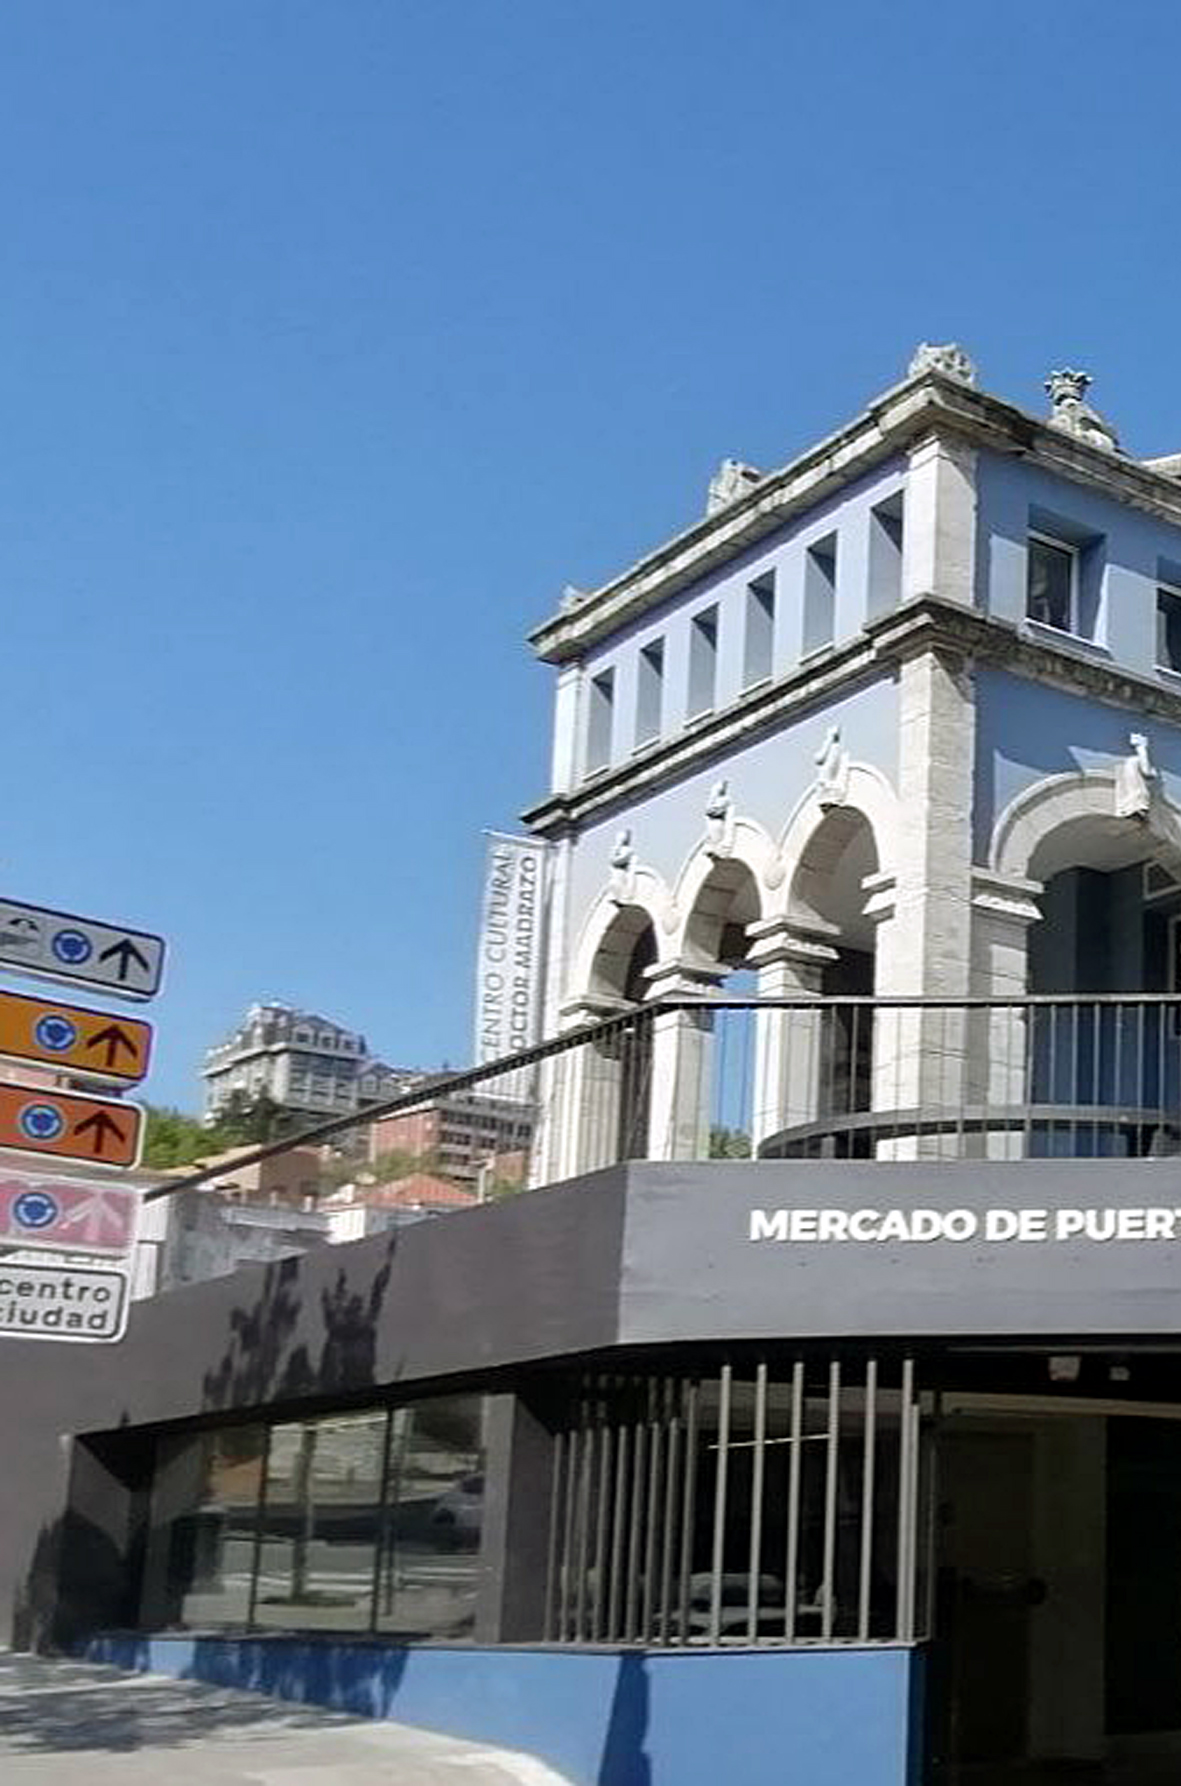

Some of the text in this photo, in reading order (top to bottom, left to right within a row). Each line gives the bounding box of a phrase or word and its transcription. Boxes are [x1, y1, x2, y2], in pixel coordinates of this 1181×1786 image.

[509, 856, 537, 1051] OCTOR MADRAZO
[750, 1208, 977, 1242] MERCADO
[985, 1208, 1048, 1242] DE
[0, 1278, 111, 1302] centro
[0, 1300, 108, 1330] iudad
